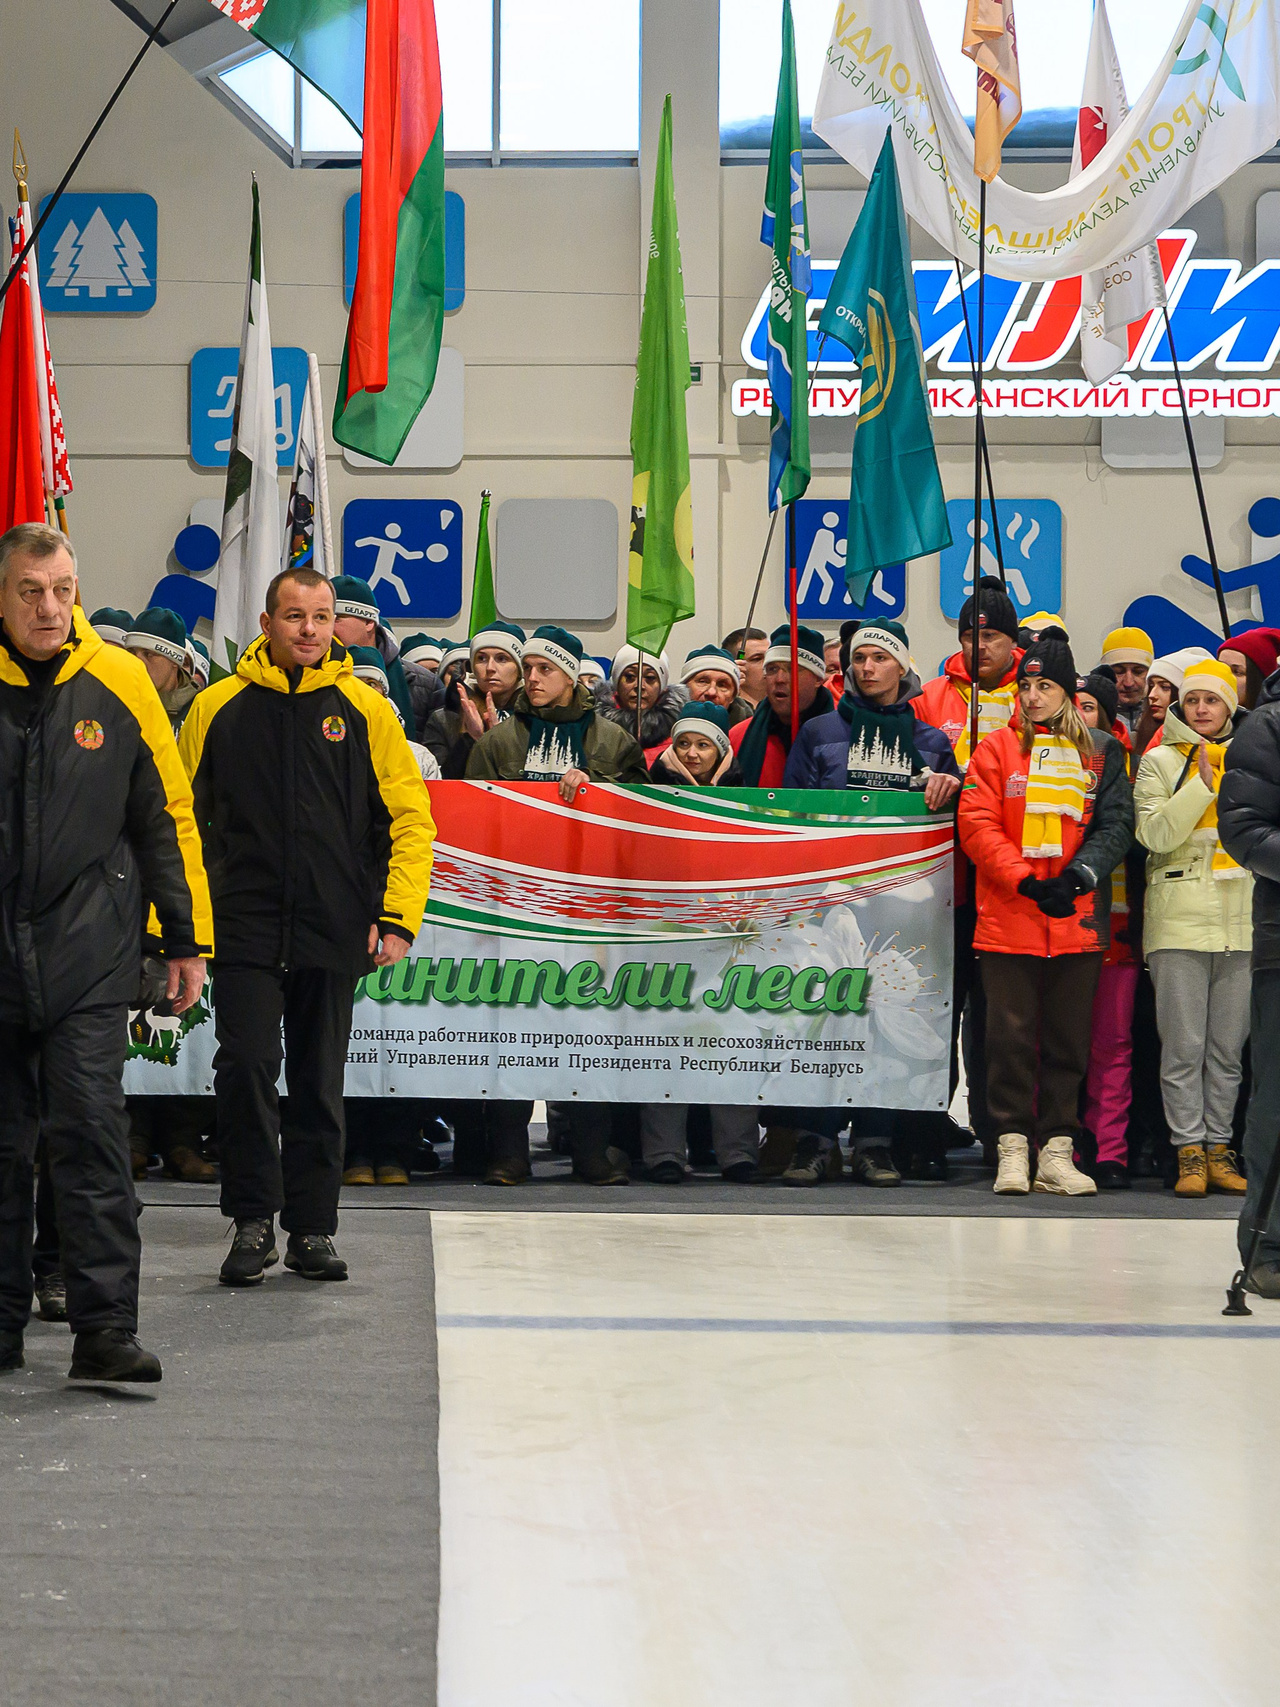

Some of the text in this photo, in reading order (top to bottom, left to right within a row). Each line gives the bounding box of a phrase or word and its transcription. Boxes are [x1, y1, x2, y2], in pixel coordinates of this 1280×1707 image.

[851, 771, 907, 783] ХРАНИТЕЛИ
[865, 779, 890, 787] ЛЕСА
[703, 964, 869, 1013] леса
[418, 1027, 517, 1046] работников
[520, 1032, 680, 1049] природоохранных
[683, 1034, 694, 1048] и
[697, 1034, 866, 1052] лесохозяйственных
[387, 1049, 490, 1068] Управления
[497, 1053, 560, 1069] делами
[569, 1053, 671, 1072] Президента
[679, 1055, 782, 1075] Республики
[790, 1058, 864, 1077] Беларусь
